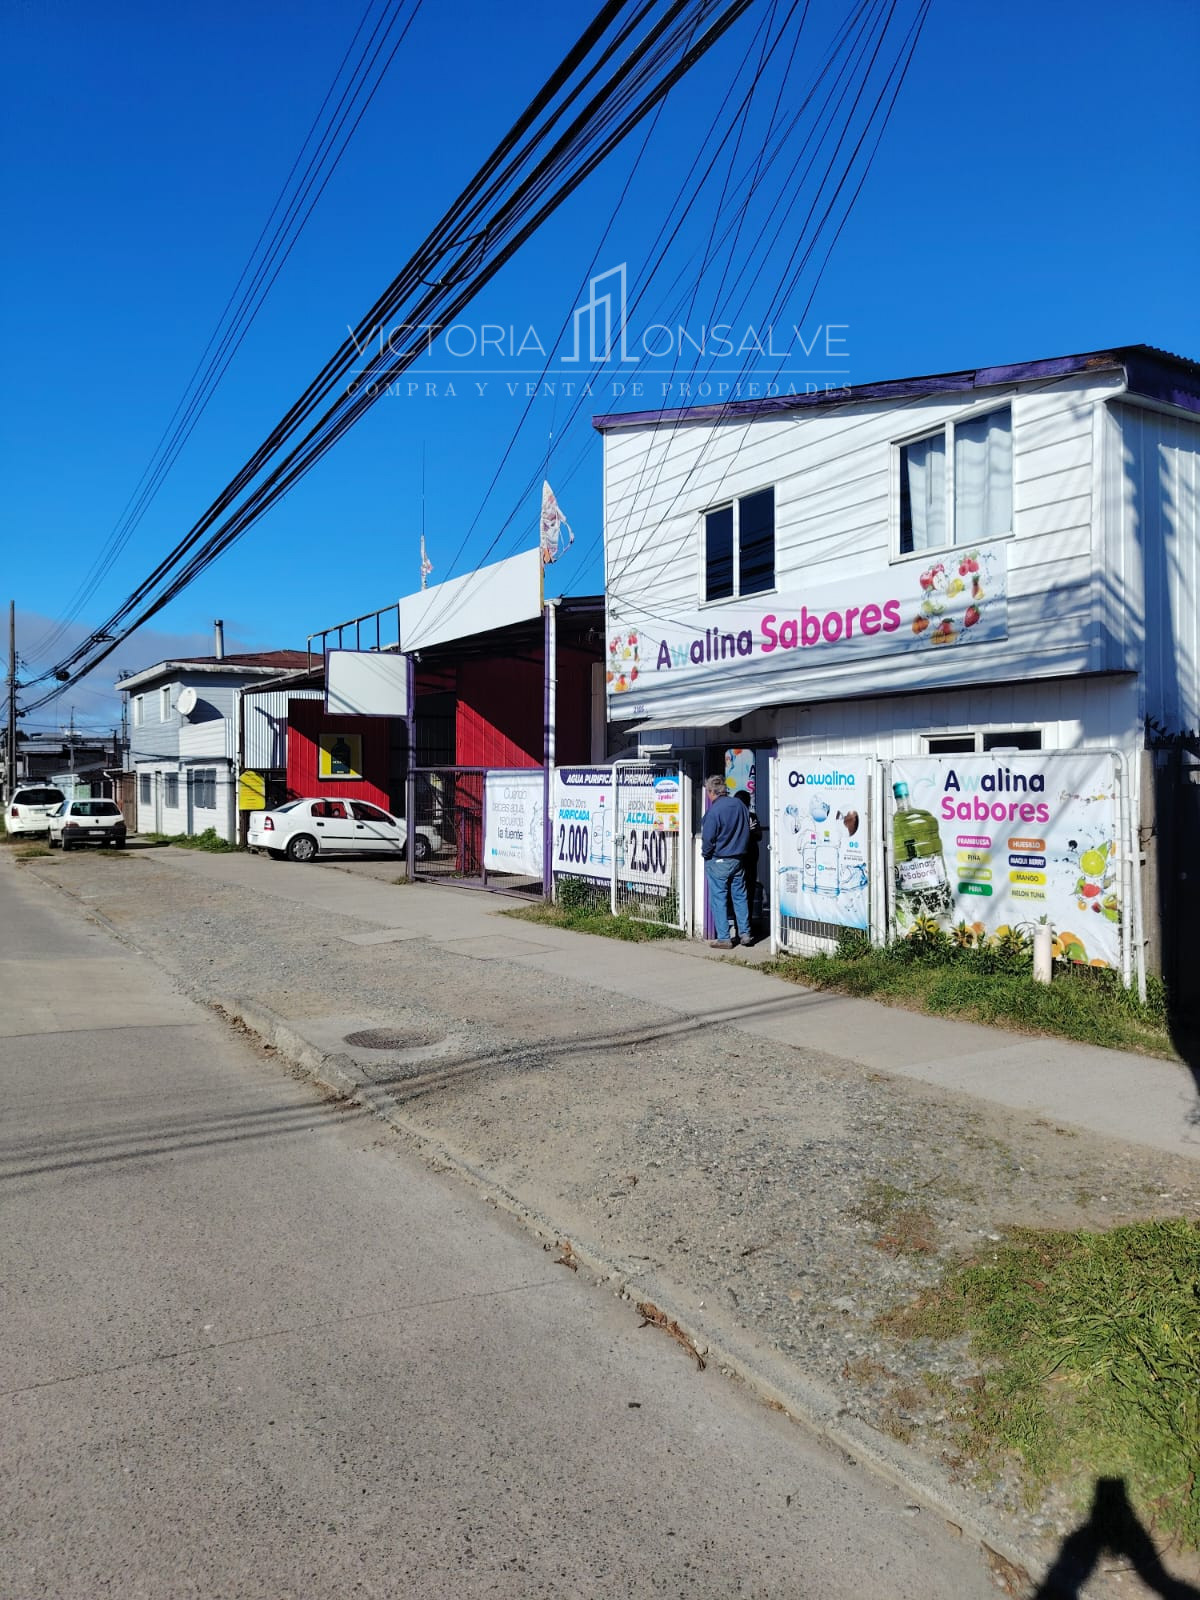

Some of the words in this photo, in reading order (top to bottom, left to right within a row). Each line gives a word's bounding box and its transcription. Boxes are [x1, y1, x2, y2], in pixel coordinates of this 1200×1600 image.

[656, 627, 753, 671] Awalina
[760, 599, 901, 653] Sabores
[566, 774, 584, 784] AGUA
[584, 774, 623, 785] PURIFICAA
[806, 770, 855, 785] awalina
[944, 768, 1045, 793] Awalina
[558, 809, 590, 821] PURIFICADA
[941, 796, 1050, 823] Sabores
[497, 826, 504, 839] la
[504, 827, 524, 840] fuente
[558, 823, 589, 865] 2.000
[1012, 841, 1041, 849] HUESILLO
[630, 829, 667, 874] 2.500
[1010, 857, 1027, 865] MAQUI
[1028, 858, 1045, 866] BERRY
[1016, 874, 1040, 882] MANGO
[968, 885, 983, 893] PERA
[1029, 891, 1046, 899] TUNA
